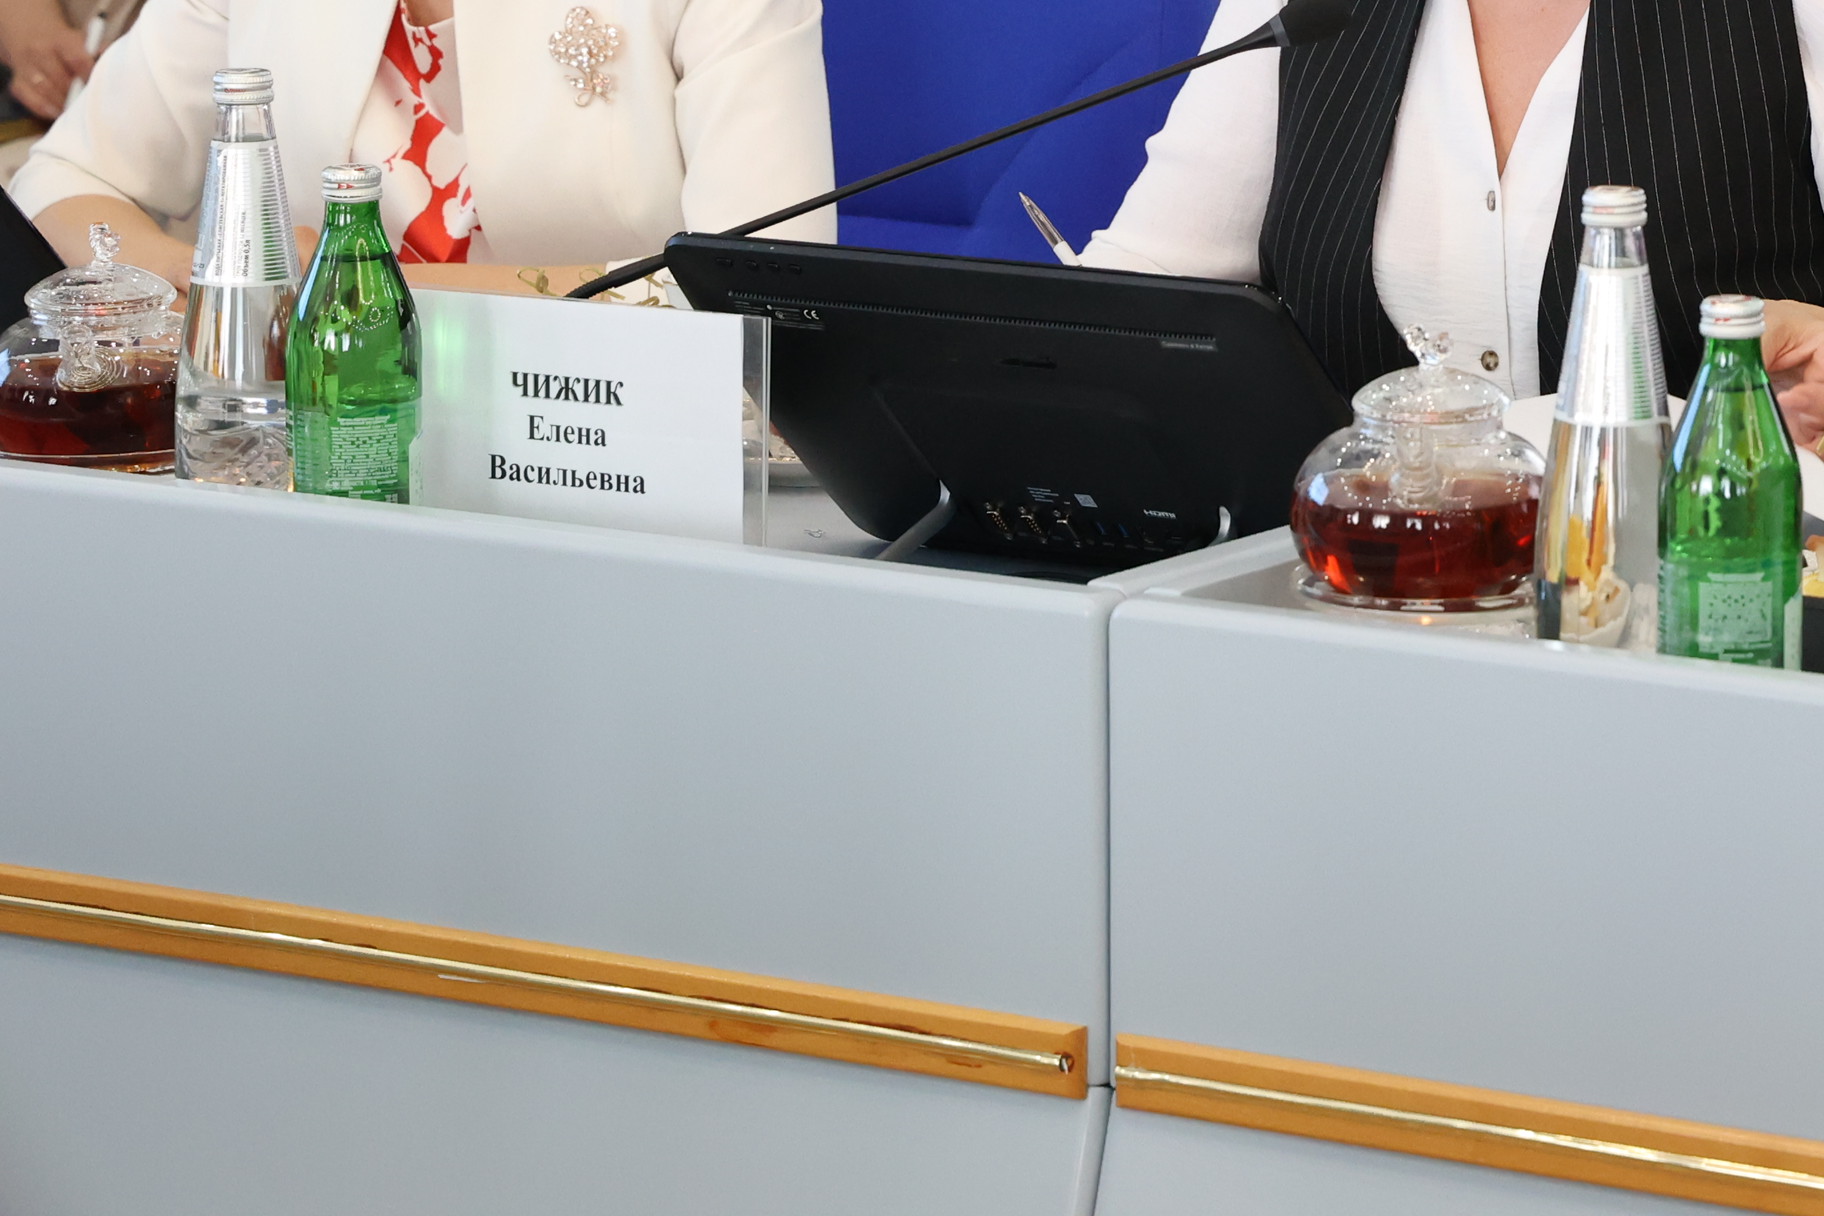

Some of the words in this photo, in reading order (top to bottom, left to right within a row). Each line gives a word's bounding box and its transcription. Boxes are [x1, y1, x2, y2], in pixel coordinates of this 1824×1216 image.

[242, 254, 250, 277] Объем
[510, 371, 624, 406] ЧИЖИК
[527, 414, 607, 447] Елена
[488, 453, 646, 494] Васильевна
